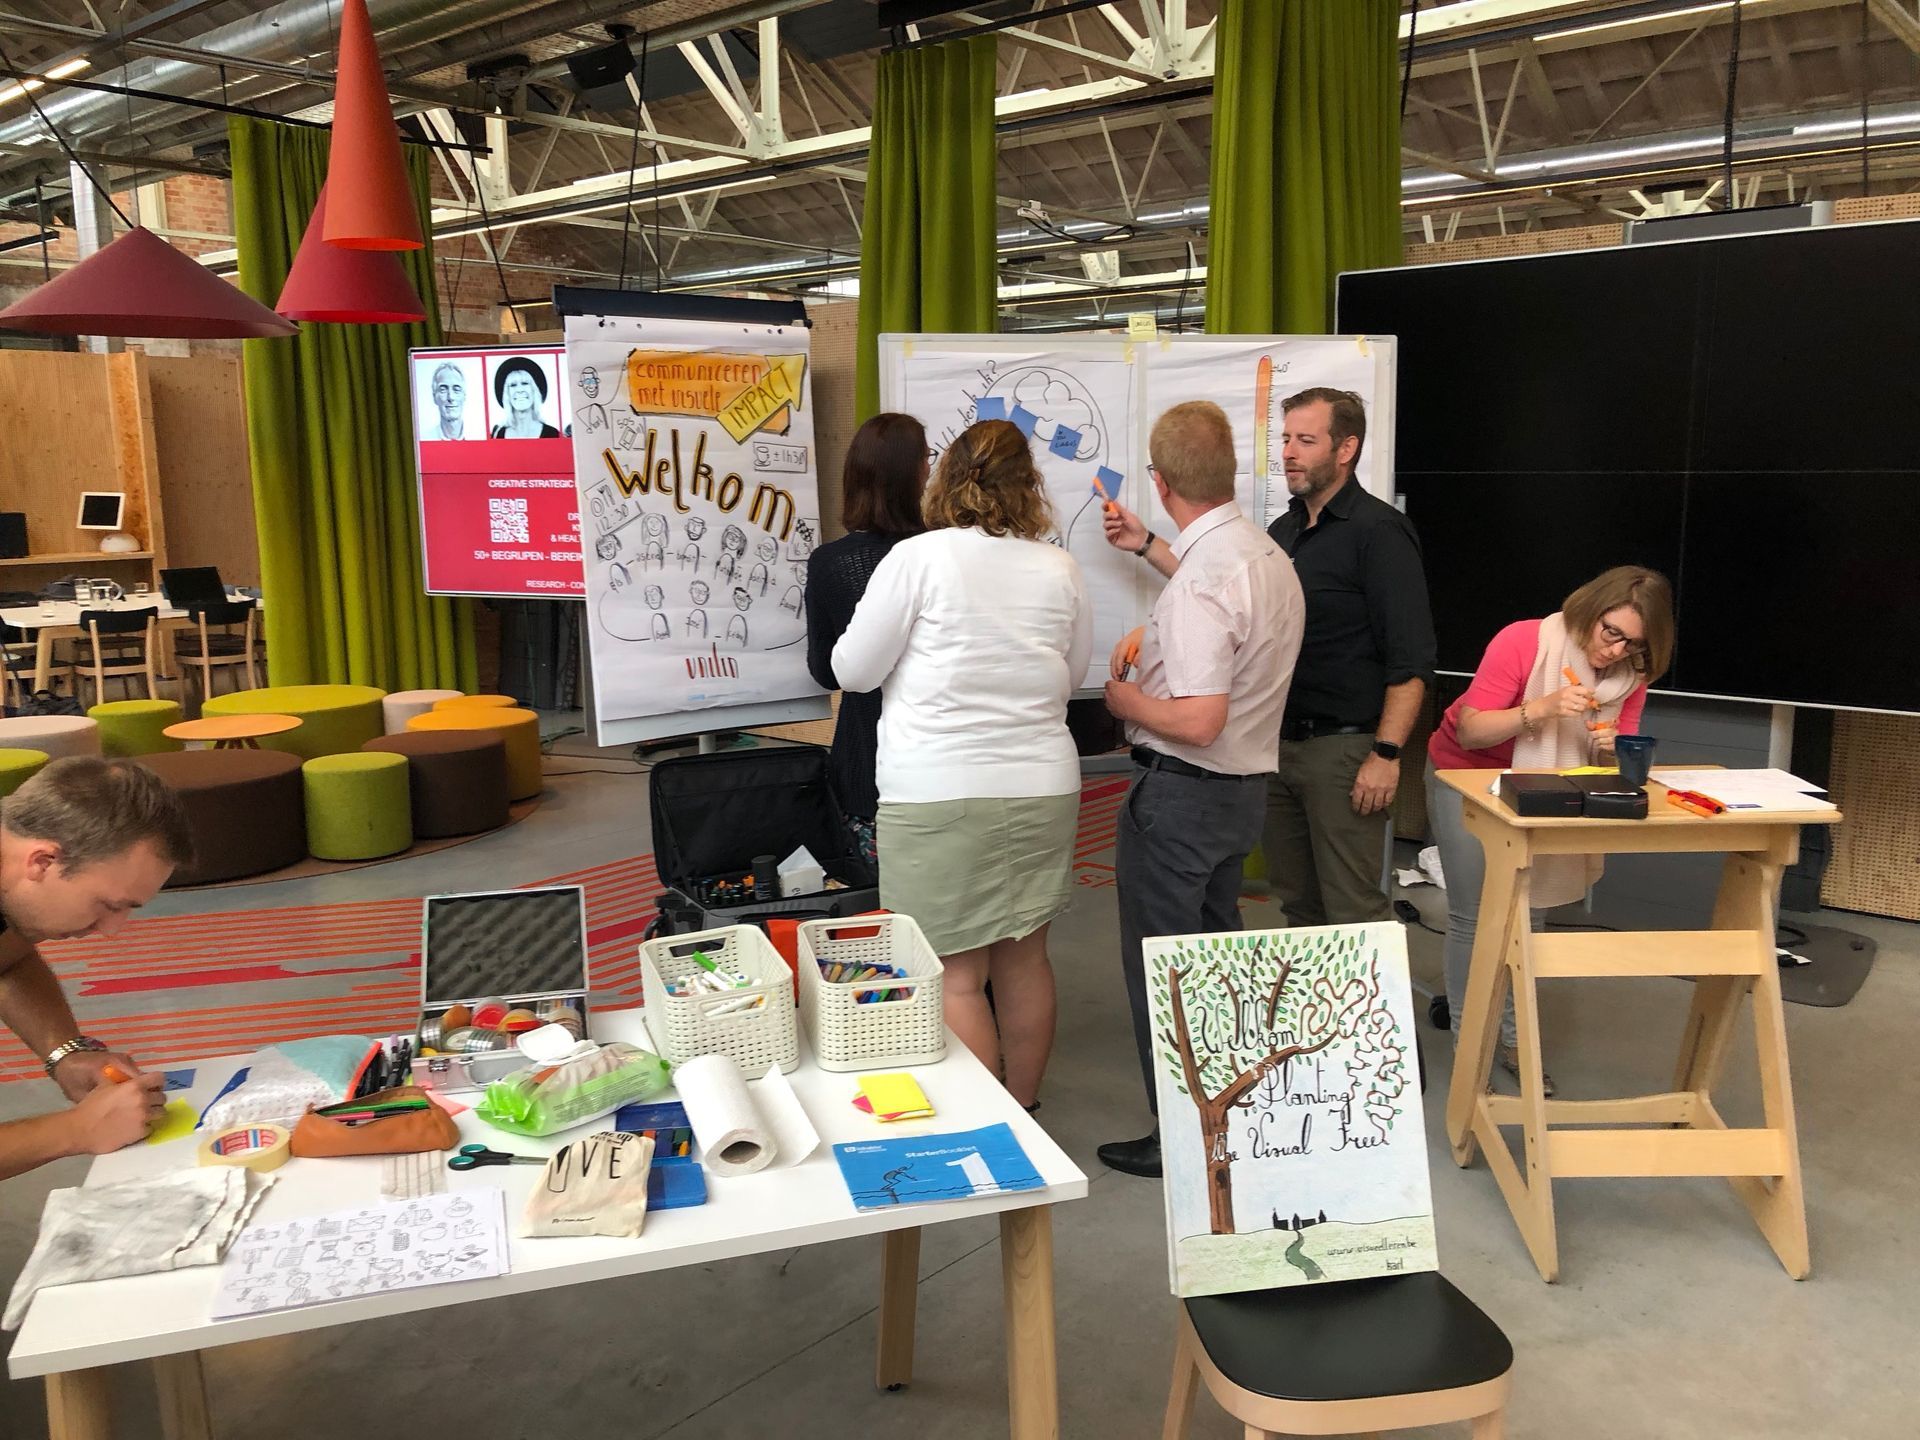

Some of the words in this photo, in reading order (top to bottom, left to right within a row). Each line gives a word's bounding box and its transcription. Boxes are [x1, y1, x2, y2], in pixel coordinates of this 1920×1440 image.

[636, 363, 762, 385] communiceren
[638, 382, 665, 407] met
[671, 385, 722, 412] visuele
[728, 361, 793, 429] IMPACT
[488, 479, 527, 488] CREATIVE
[528, 480, 574, 488] STRATEGIC
[602, 428, 796, 542] Welkom
[474, 550, 490, 560] 50+
[526, 580, 565, 589] RESEARCH
[1256, 1058, 1351, 1124] Planting
[1247, 1111, 1313, 1159] Visual
[945, 1151, 1013, 1198] 1
